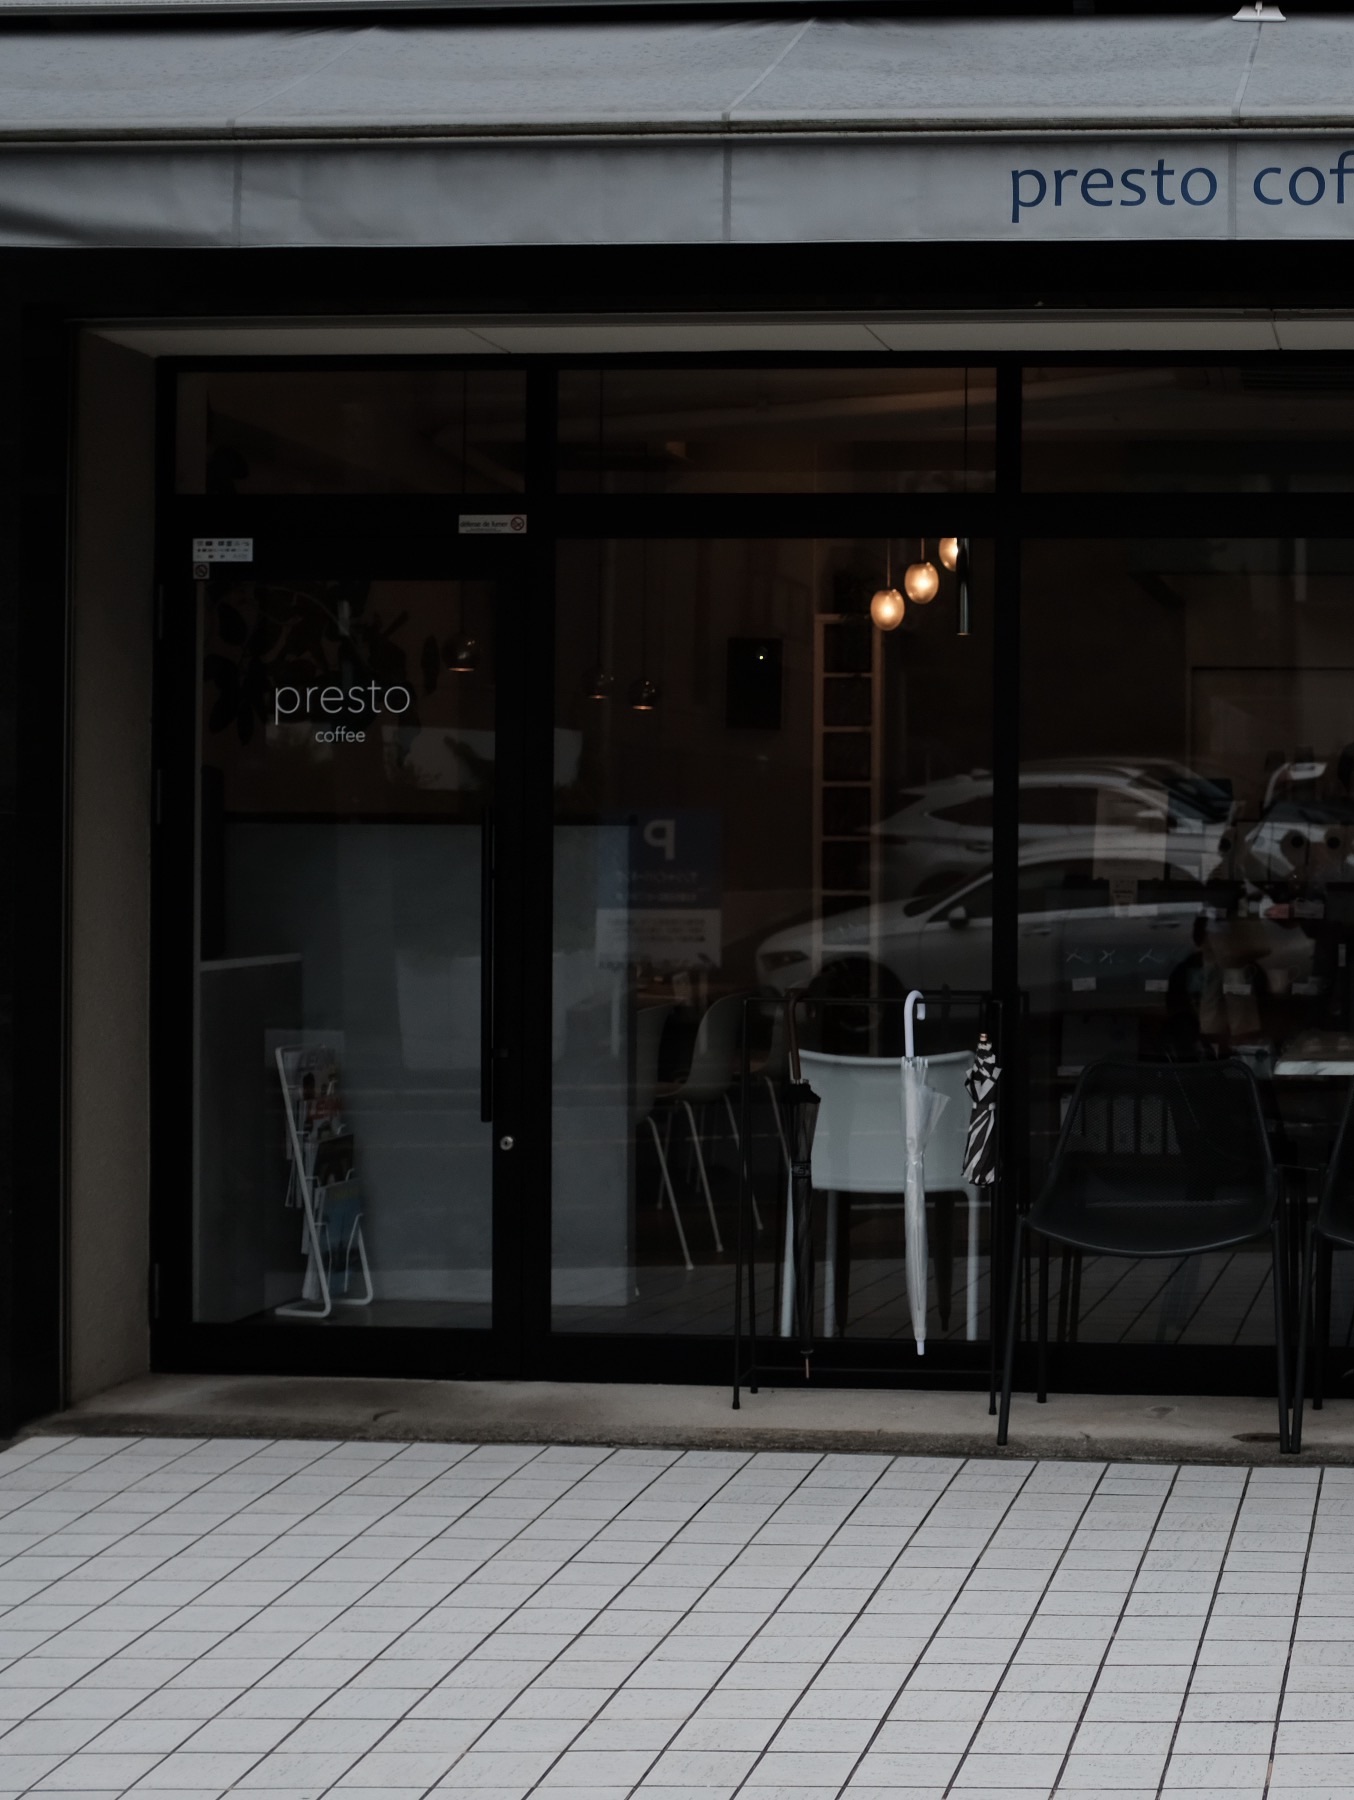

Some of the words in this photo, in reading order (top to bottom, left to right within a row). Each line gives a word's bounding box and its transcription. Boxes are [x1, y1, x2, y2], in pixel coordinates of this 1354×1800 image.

[1012, 159, 1218, 223] presto
[274, 679, 411, 725] presto
[315, 726, 366, 743] coffee
